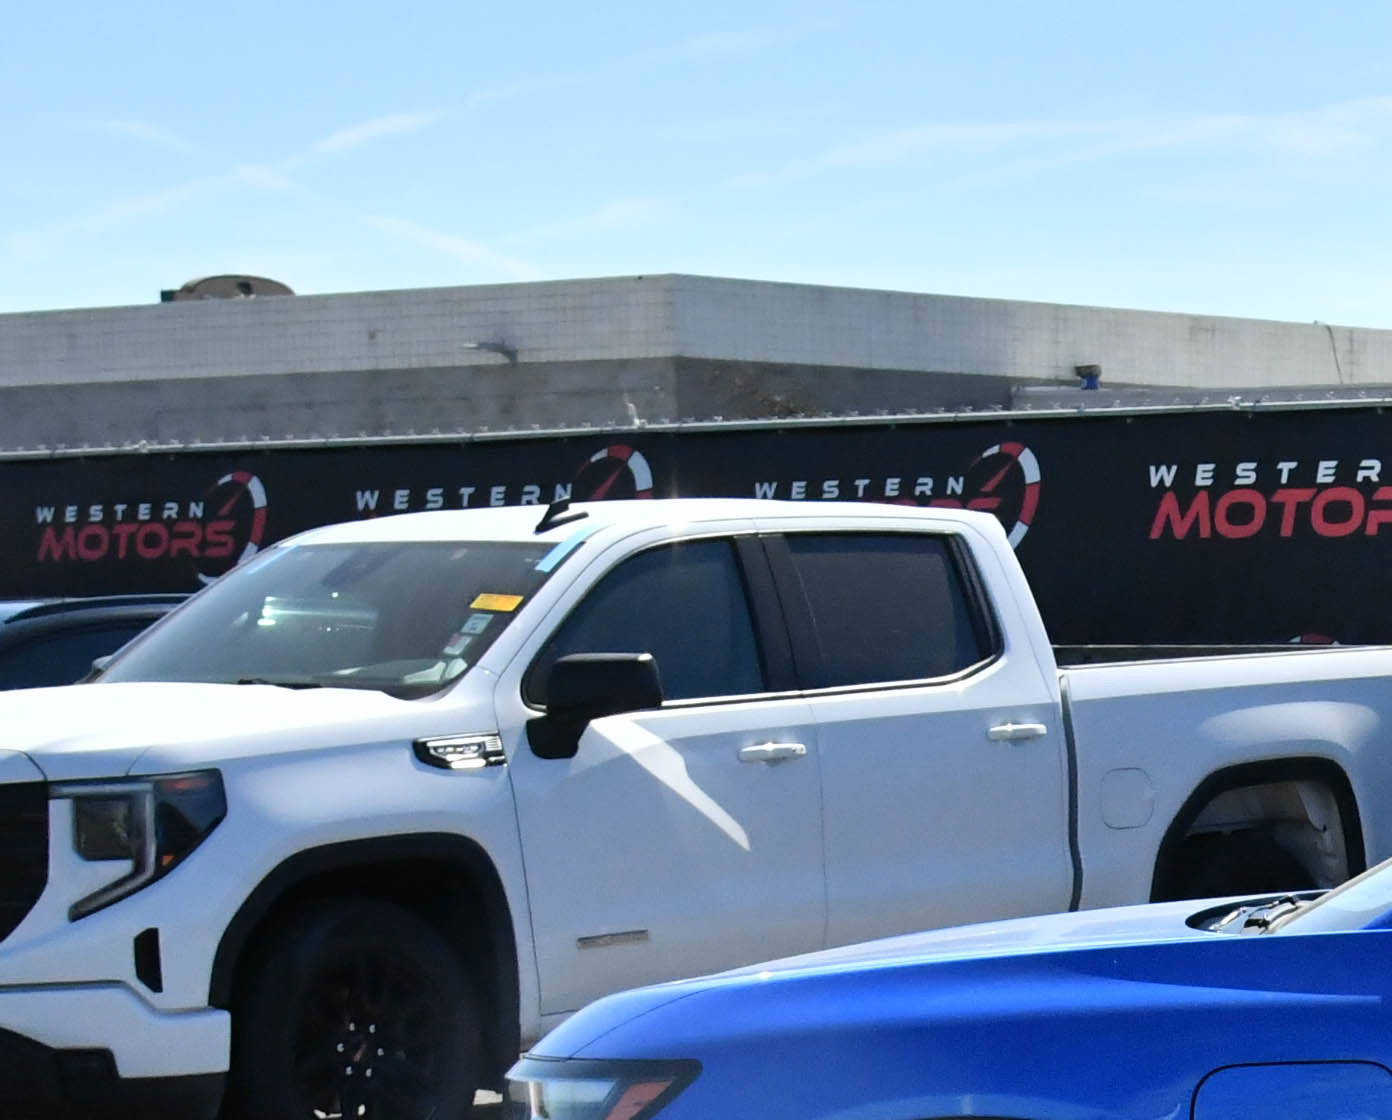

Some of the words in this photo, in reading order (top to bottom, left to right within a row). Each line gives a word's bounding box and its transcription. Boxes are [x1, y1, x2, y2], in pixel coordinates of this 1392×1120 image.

[755, 476, 964, 499] WESTERN
[36, 502, 204, 523] WESTERN
[37, 521, 235, 560] MOTORS
